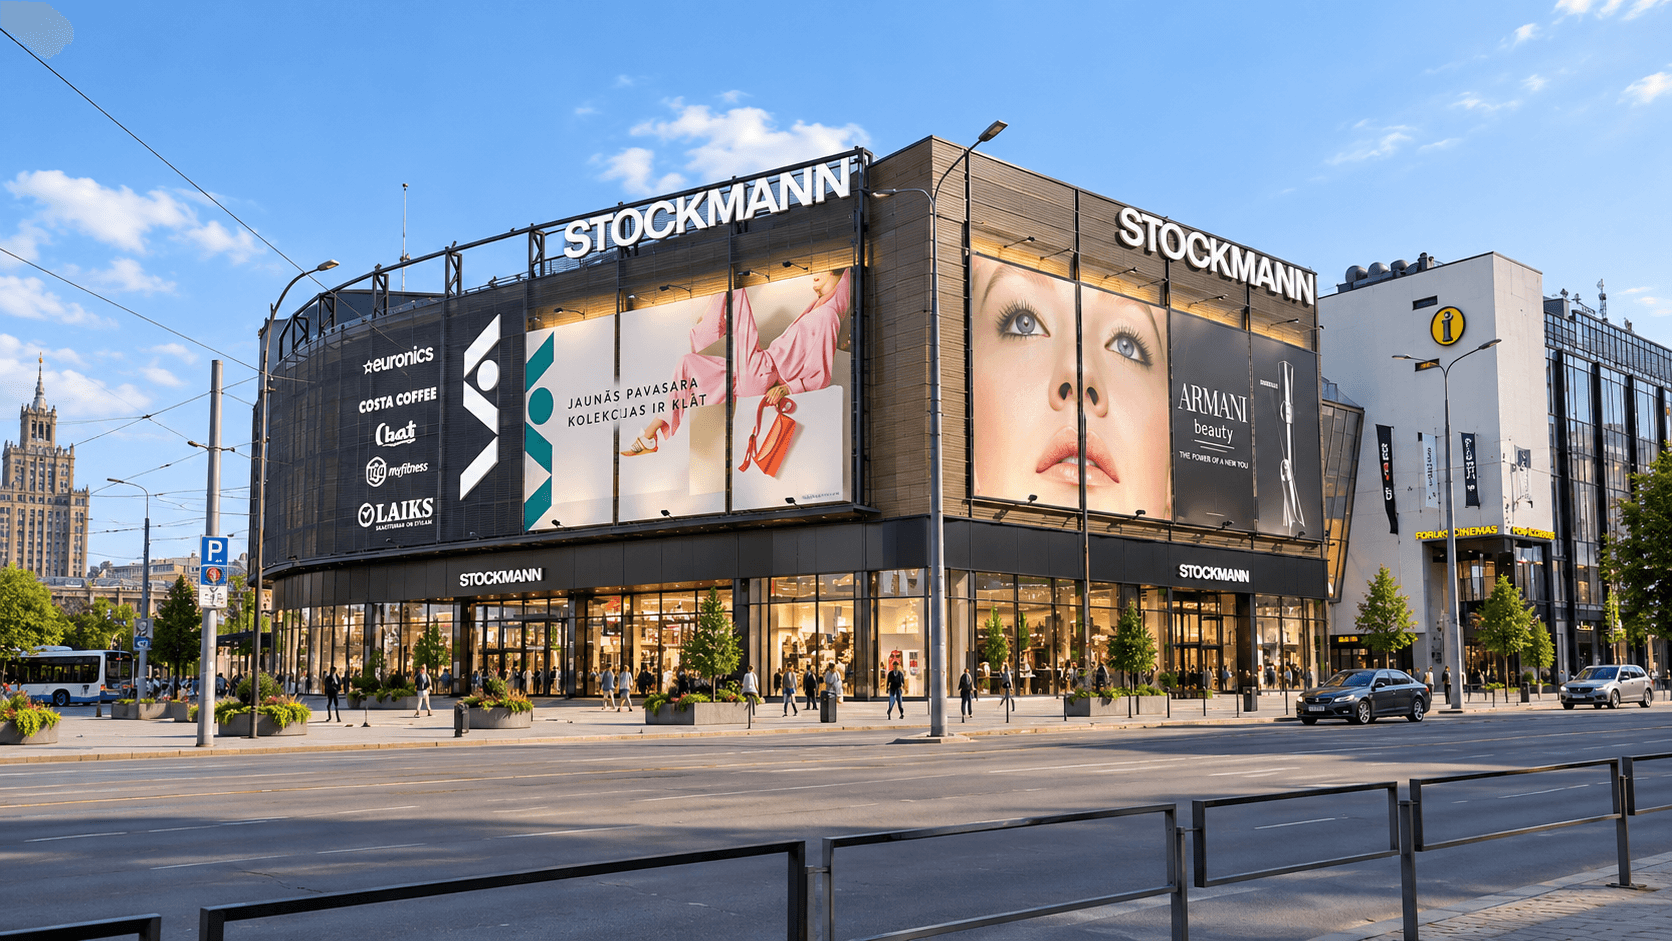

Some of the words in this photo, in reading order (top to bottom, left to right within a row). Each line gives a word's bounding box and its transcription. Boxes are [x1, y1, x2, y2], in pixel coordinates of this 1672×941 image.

[563, 156, 850, 259] STOCKMANN
[1118, 207, 1314, 305] STOCKMANN
[373, 345, 434, 372] euronics
[627, 377, 698, 399] PAVASARA
[358, 395, 394, 414] COSTA
[396, 386, 437, 406] COFFEE
[653, 401, 665, 414] IR
[1178, 383, 1248, 423] ARMANI
[1194, 418, 1234, 444] beauty
[1179, 450, 1191, 460] THE
[1192, 453, 1211, 463] POWER
[1211, 456, 1219, 464] OF
[388, 462, 429, 478] myfitness
[376, 498, 434, 523] LAIKS
[208, 540, 223, 561] P
[459, 567, 542, 587] STOCKMANN
[1179, 563, 1250, 583] STOCKMANN
